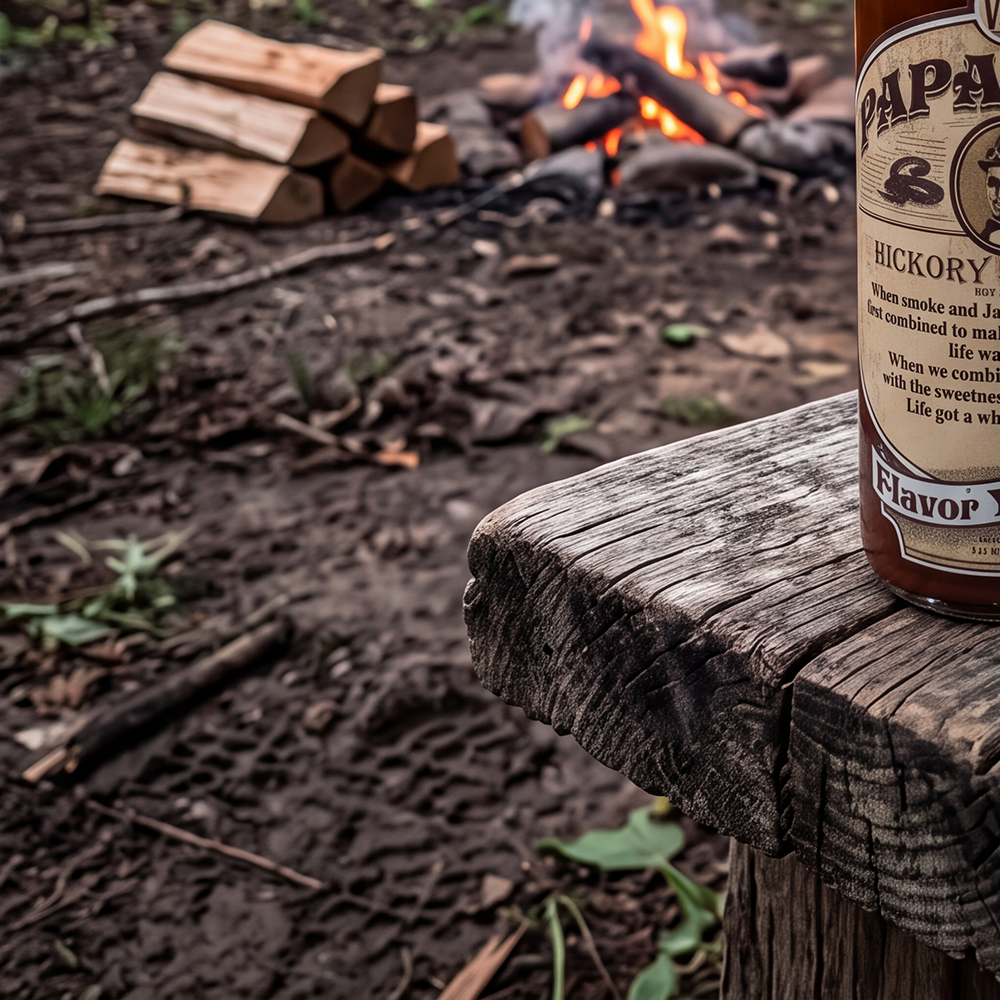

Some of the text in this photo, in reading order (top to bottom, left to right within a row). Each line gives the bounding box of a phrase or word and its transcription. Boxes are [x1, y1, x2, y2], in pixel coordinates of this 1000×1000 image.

[874, 239, 992, 285] HICKORY
[871, 281, 899, 305] When
[901, 297, 945, 315] smoke
[948, 302, 978, 318] and
[885, 314, 948, 336] combined
[951, 323, 968, 339] to
[888, 350, 925, 375] When
[928, 365, 948, 379] we
[948, 342, 974, 360] life
[882, 372, 907, 391] with
[910, 379, 932, 397] the
[906, 397, 932, 418] Life
[935, 408, 960, 425] got
[963, 411, 973, 424] a
